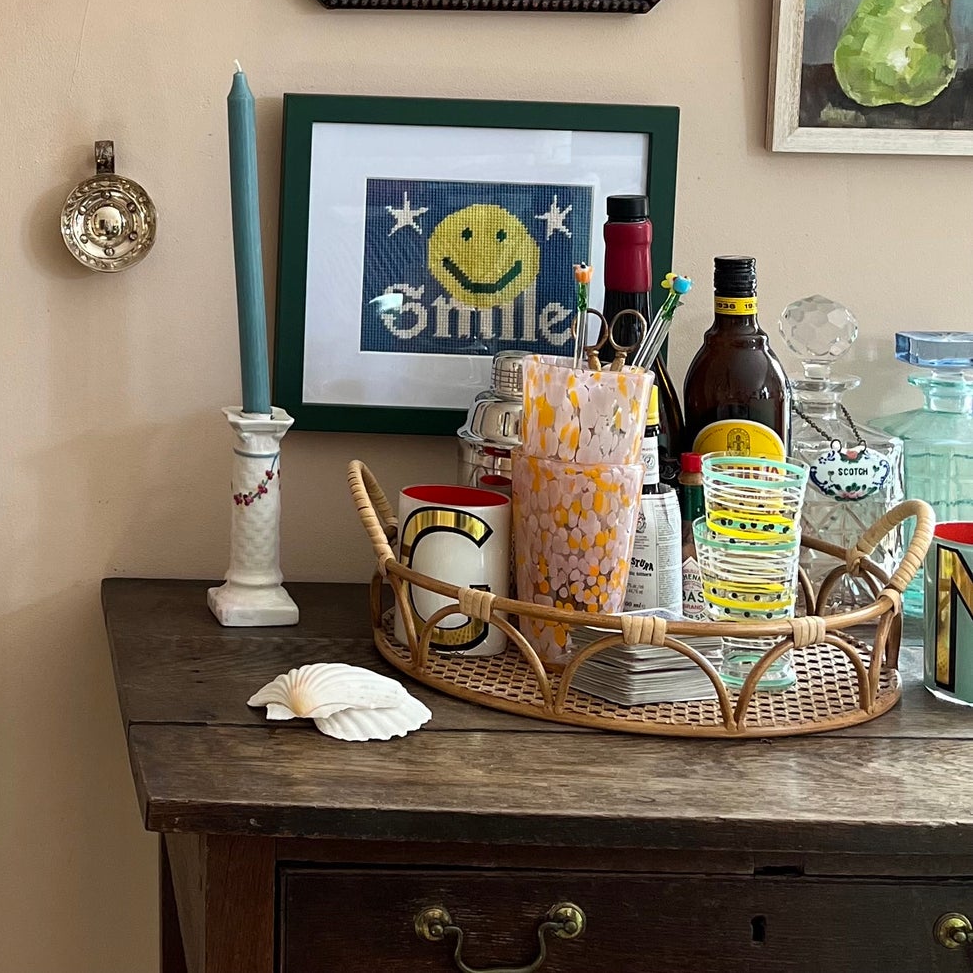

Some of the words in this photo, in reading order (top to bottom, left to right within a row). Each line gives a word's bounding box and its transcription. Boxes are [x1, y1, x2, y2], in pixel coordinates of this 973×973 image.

[380, 277, 573, 346] Smile
[837, 467, 868, 476] SCOTCH
[630, 557, 654, 571] STURA
